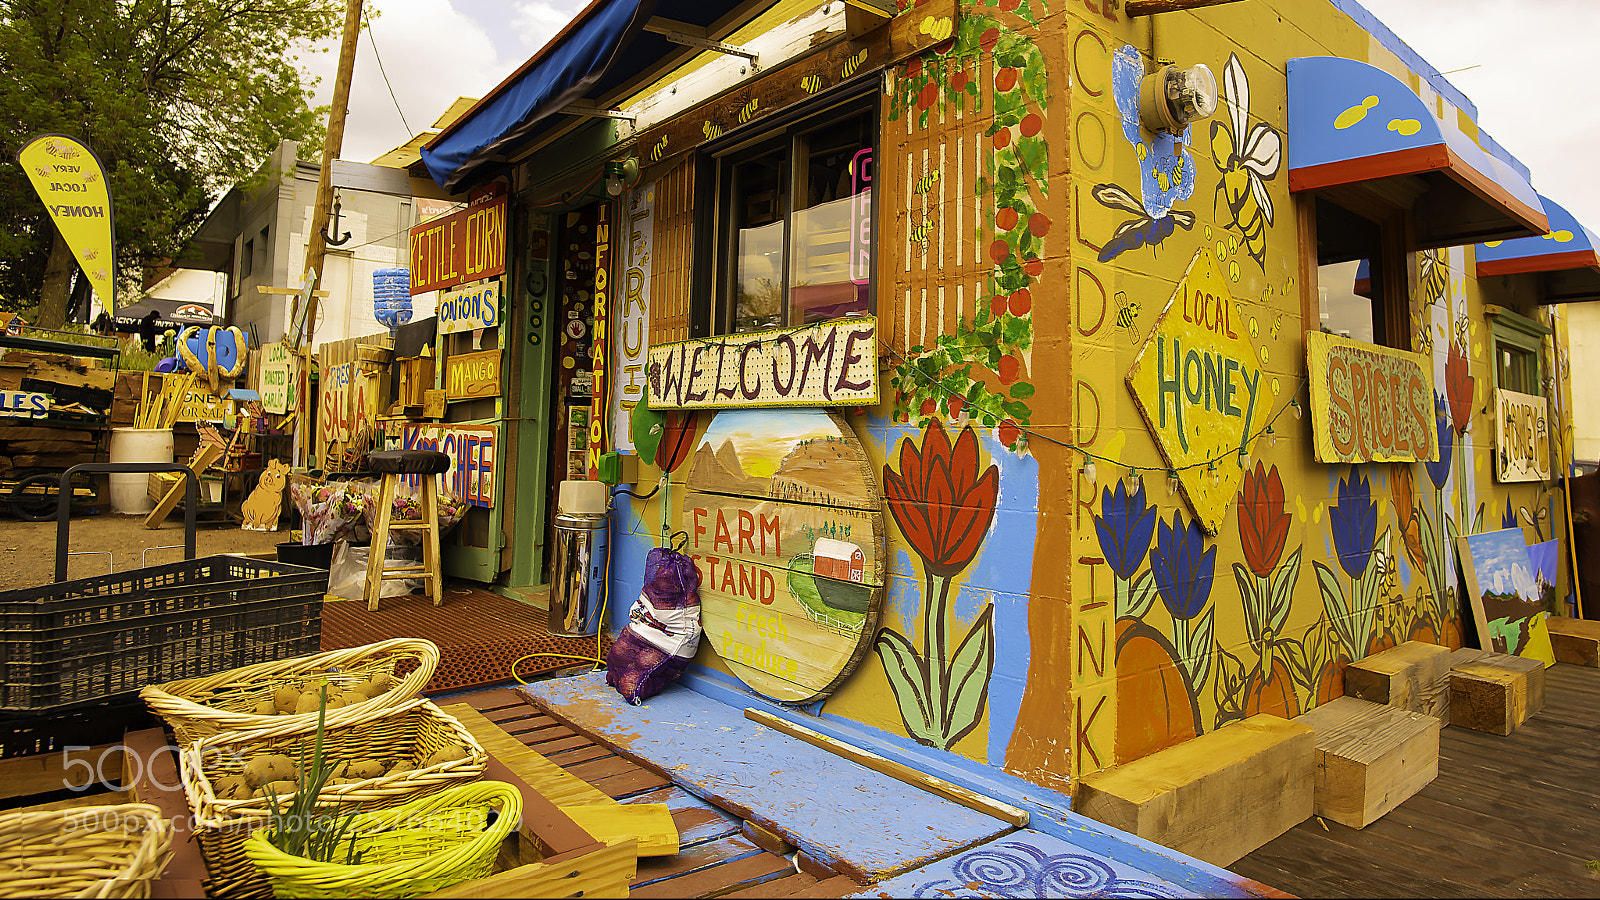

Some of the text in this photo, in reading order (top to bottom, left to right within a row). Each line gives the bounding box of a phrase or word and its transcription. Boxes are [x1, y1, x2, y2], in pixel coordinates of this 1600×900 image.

[1073, 29, 1107, 337] COLD
[409, 202, 506, 289] KETTLE CORN
[588, 204, 609, 470] INFORMATION
[619, 209, 650, 444] FRUIT
[1182, 282, 1239, 341] LOCAL
[450, 360, 495, 397] MANGO
[662, 325, 875, 407] WELCOME
[1157, 335, 1261, 455] HONEY
[324, 385, 366, 440] SALA
[1329, 355, 1430, 461] SPICES
[1501, 398, 1538, 464] HONEY
[693, 507, 782, 558] FARM
[691, 554, 776, 606] STAND
[1076, 380, 1109, 778] DRINK
[721, 630, 798, 682] Produce
